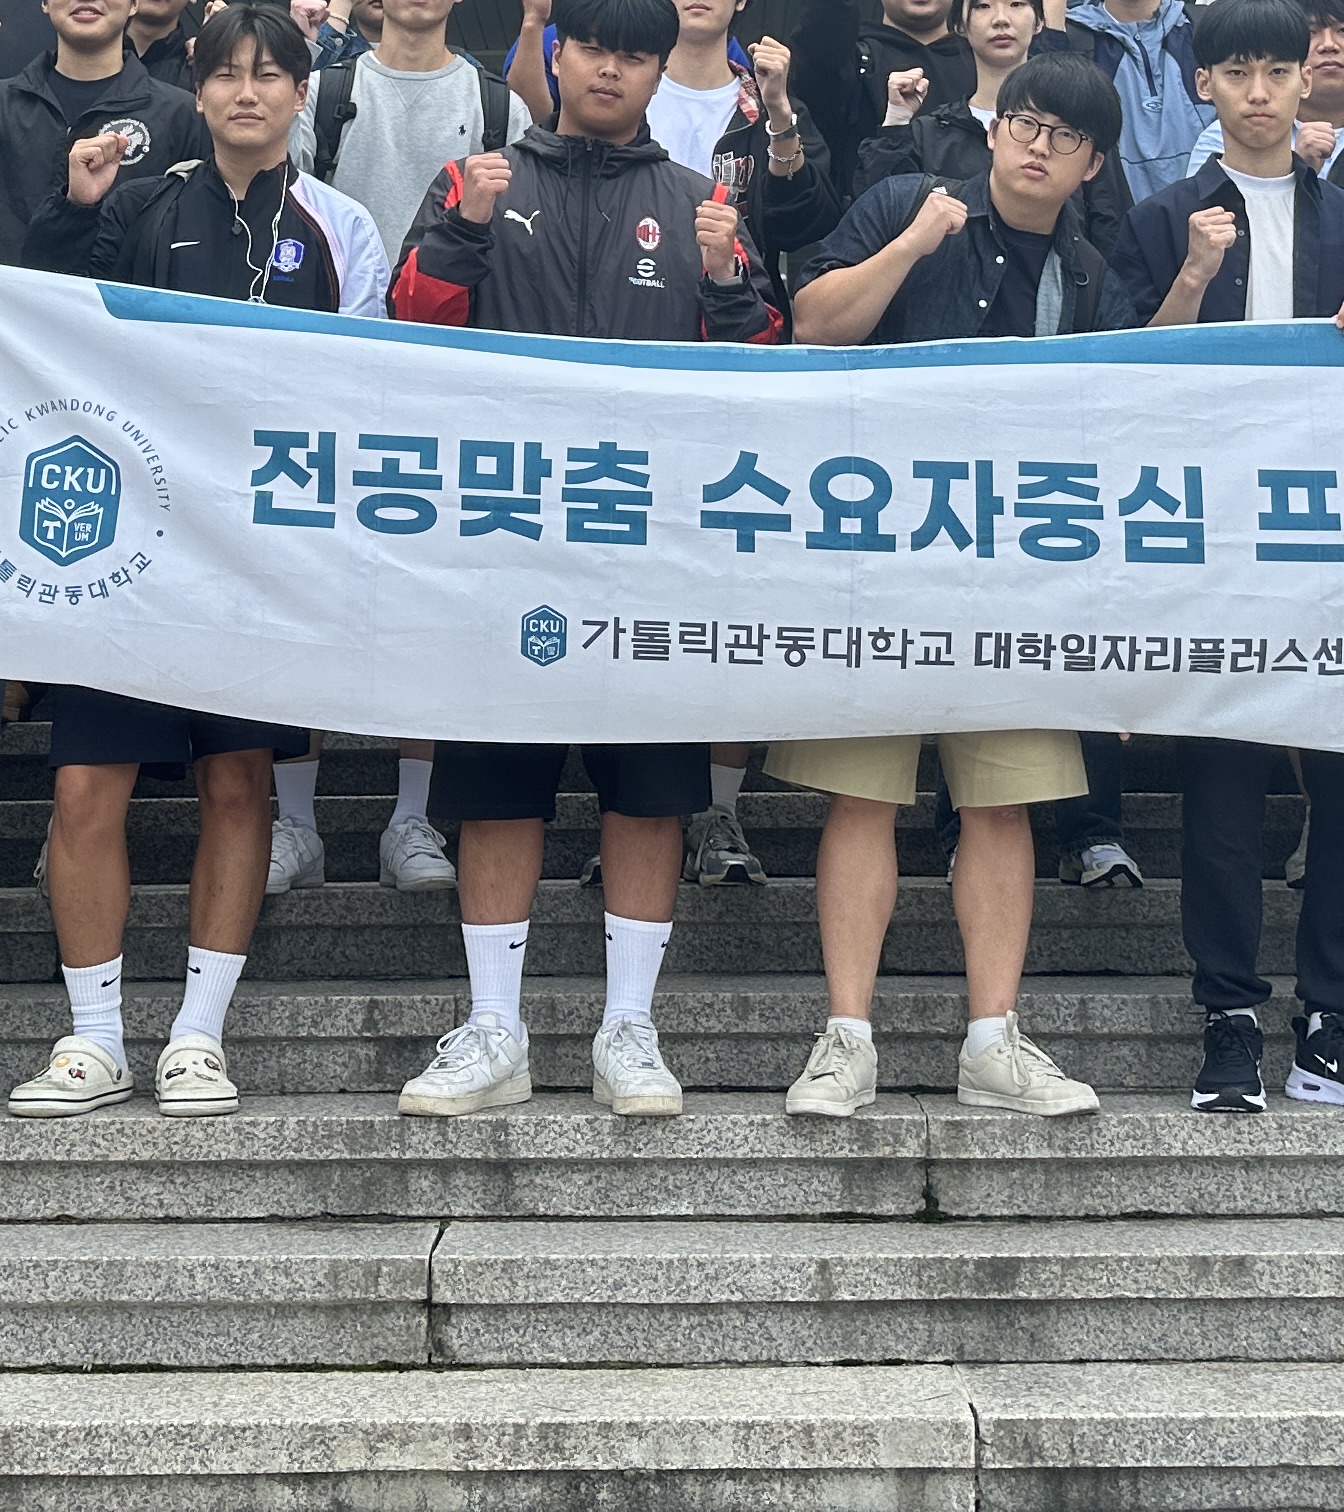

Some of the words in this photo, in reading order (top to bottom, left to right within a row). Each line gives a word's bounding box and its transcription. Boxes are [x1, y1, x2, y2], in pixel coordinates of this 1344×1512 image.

[24, 398, 118, 423] KWANDONG
[121, 420, 172, 513] UNIVERSITY
[41, 463, 106, 494] CKU
[250, 429, 654, 546] 전공맞춤
[699, 449, 1206, 565] 수요자중심
[73, 521, 92, 533] VER
[529, 619, 560, 633] CKU
[581, 616, 956, 670] 가톨릭관동대학교
